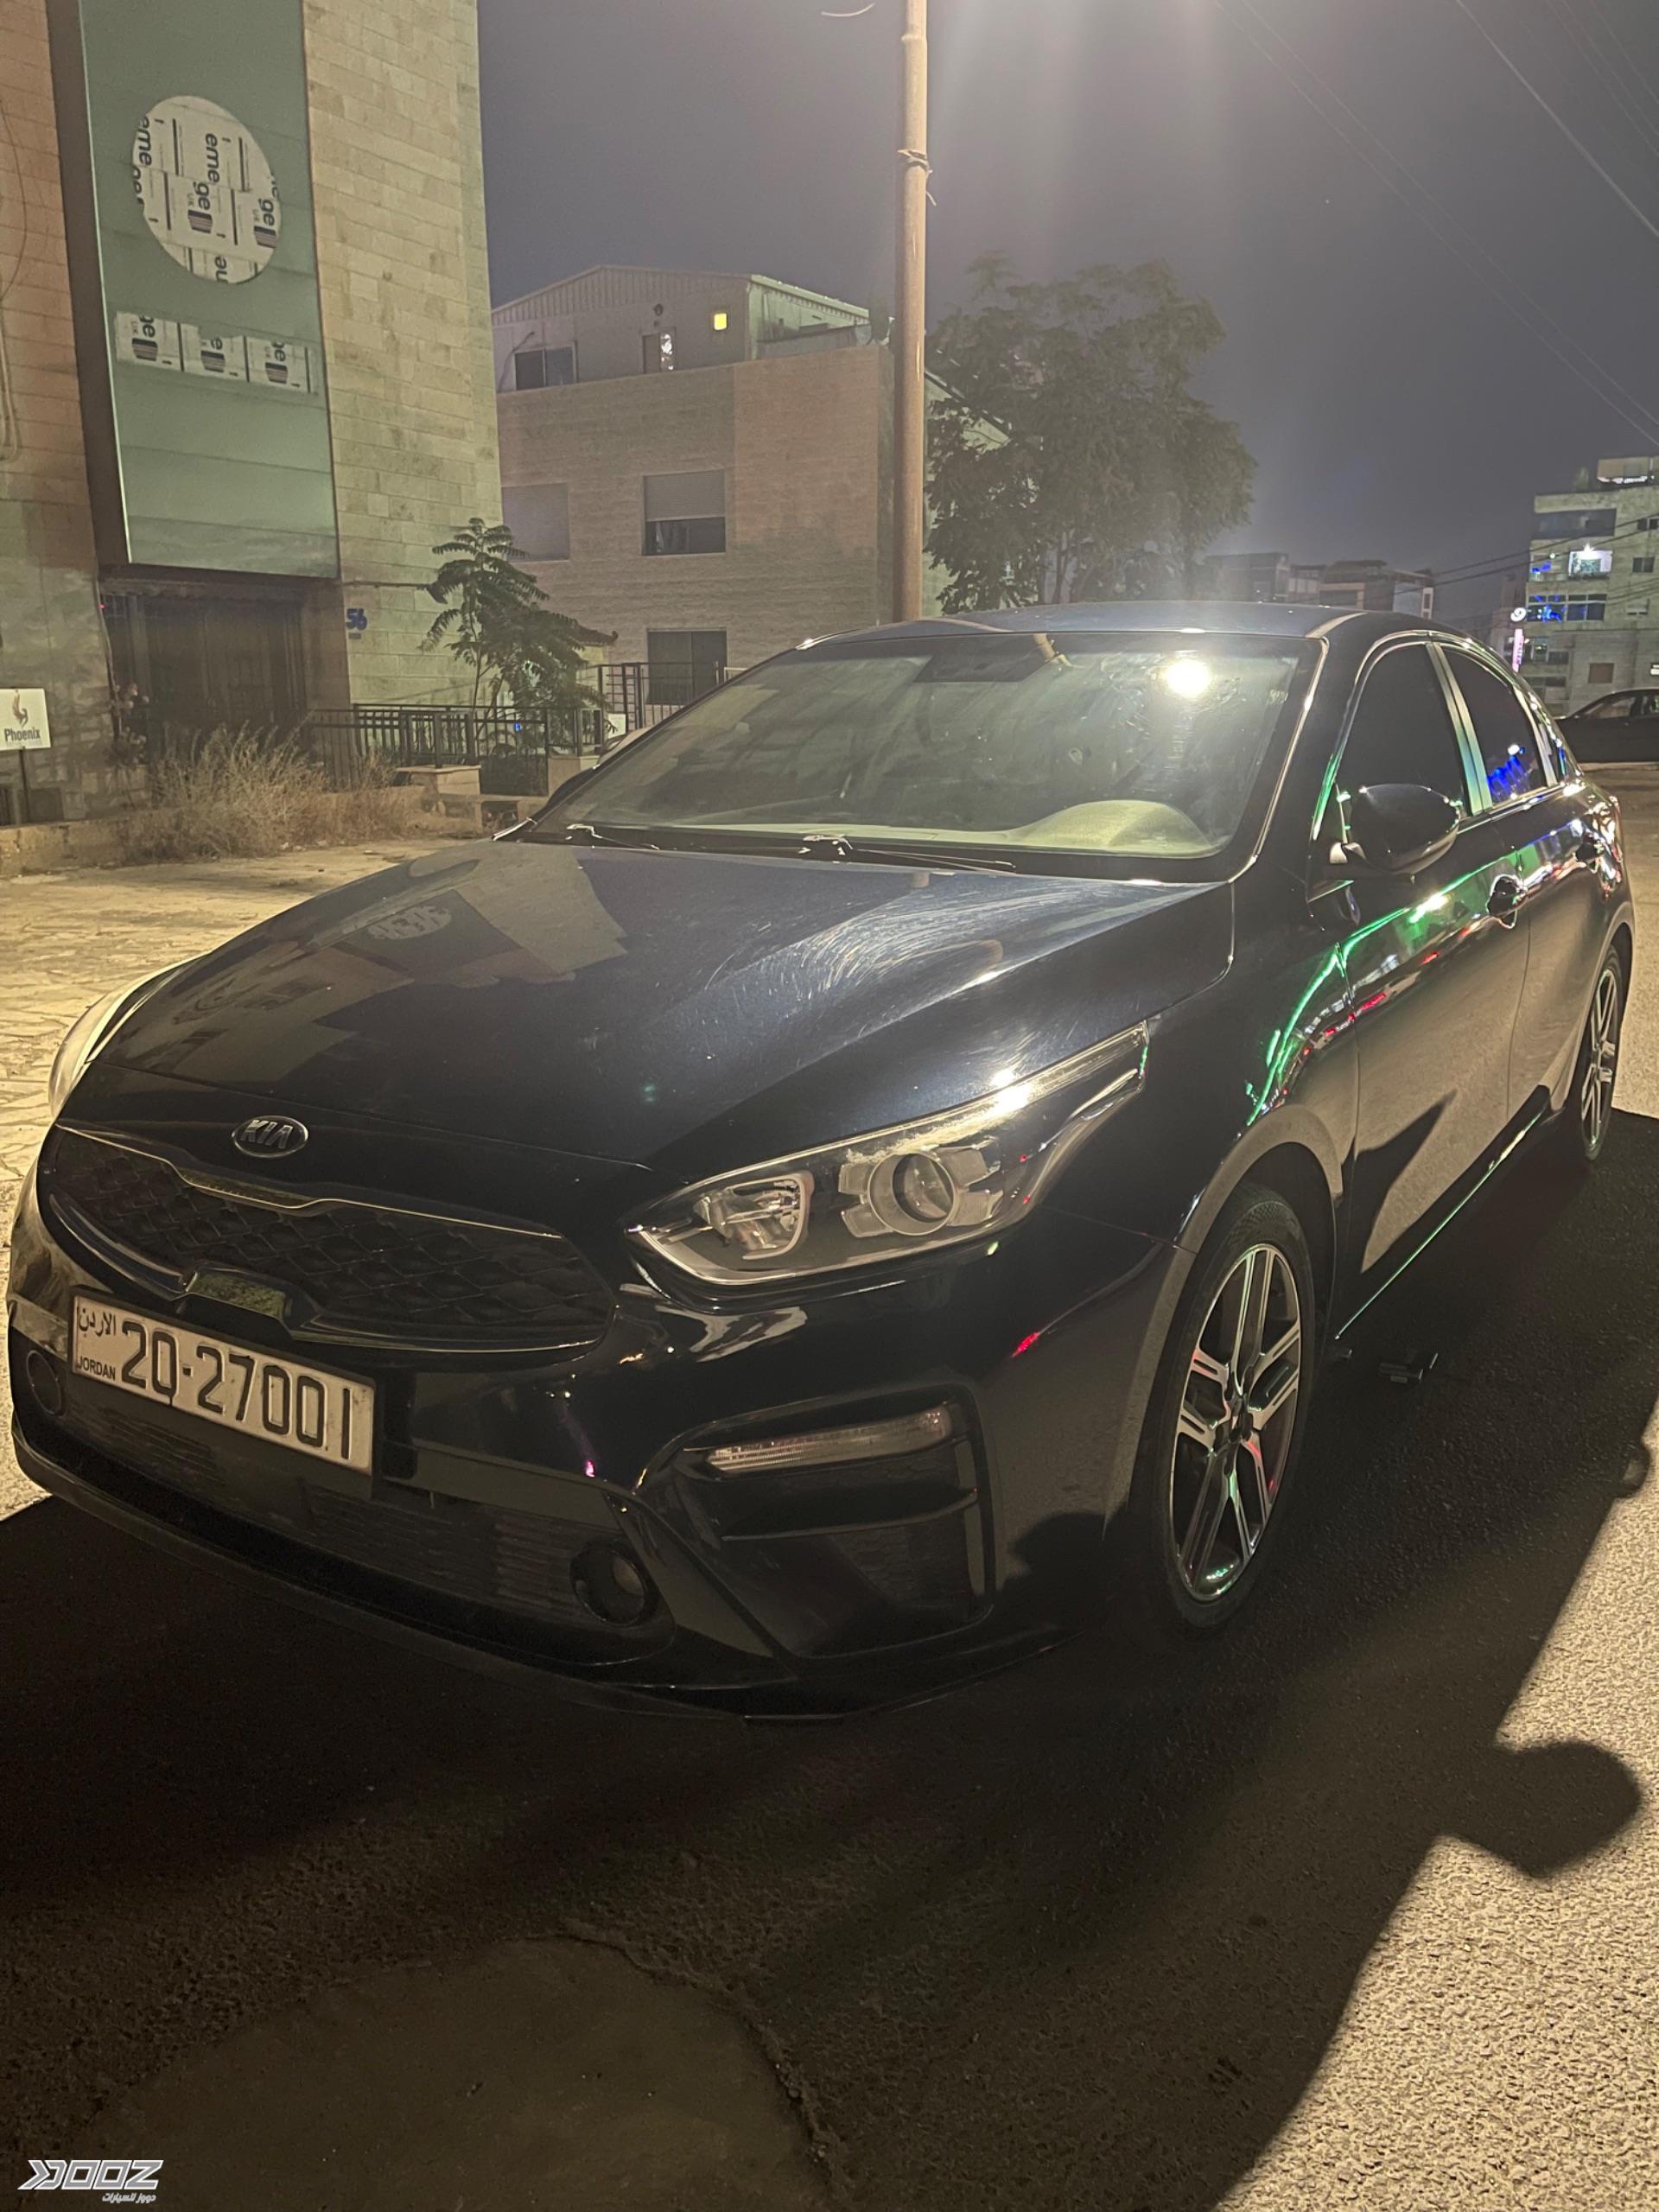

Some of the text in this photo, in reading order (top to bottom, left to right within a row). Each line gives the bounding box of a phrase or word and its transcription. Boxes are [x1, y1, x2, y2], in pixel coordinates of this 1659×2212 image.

[4, 727, 41, 741] Phoenix
[240, 1119, 294, 1149] KIA
[76, 1355, 116, 1381] JORDAN
